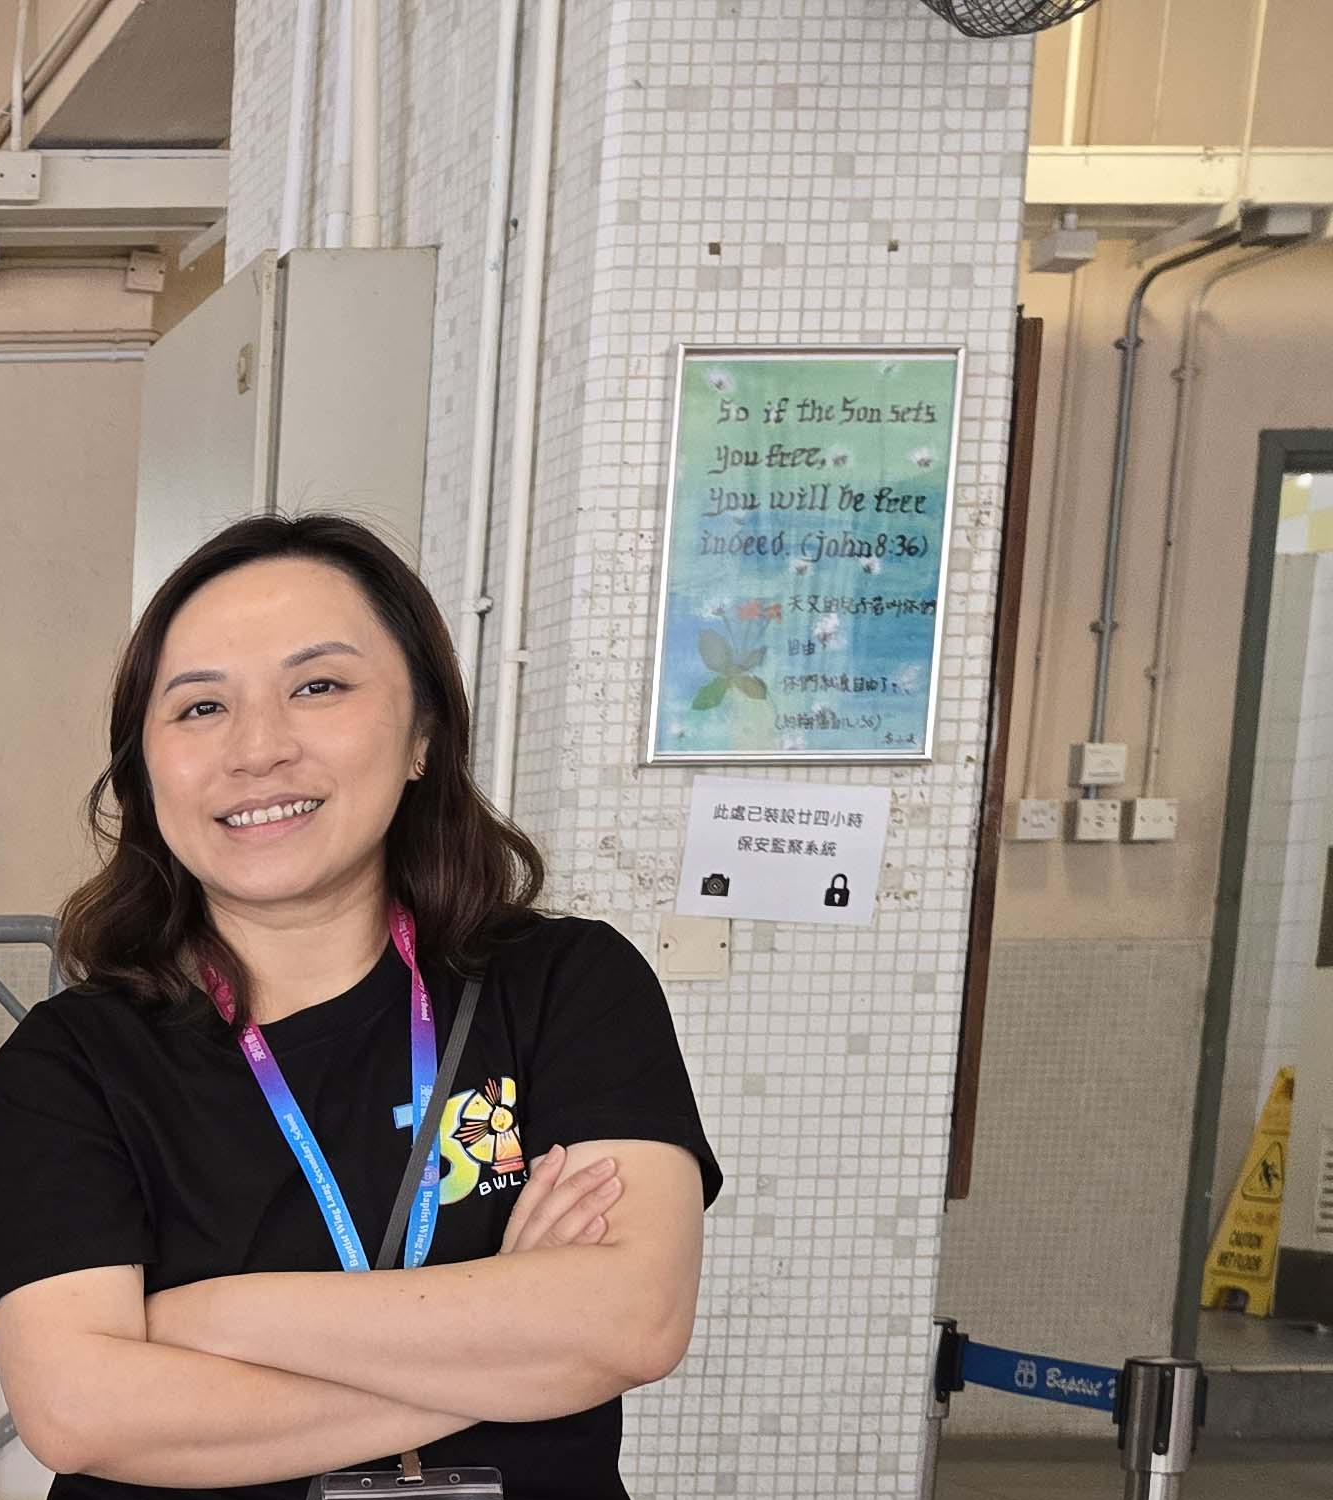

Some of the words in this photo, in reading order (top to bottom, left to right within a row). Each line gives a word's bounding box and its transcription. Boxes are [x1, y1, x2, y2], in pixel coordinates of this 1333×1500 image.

[717, 399, 749, 424] So
[763, 398, 790, 424] if
[797, 398, 835, 423] the
[838, 397, 882, 425] Son
[888, 402, 937, 424] sets
[707, 445, 761, 474] you
[765, 444, 826, 470] free,
[701, 487, 761, 517] you
[769, 484, 830, 511] will
[838, 484, 866, 512] be
[874, 487, 927, 514] free
[712, 804, 863, 828] 此處已裝設廿四小時
[737, 836, 837, 857] 保安監察系統
